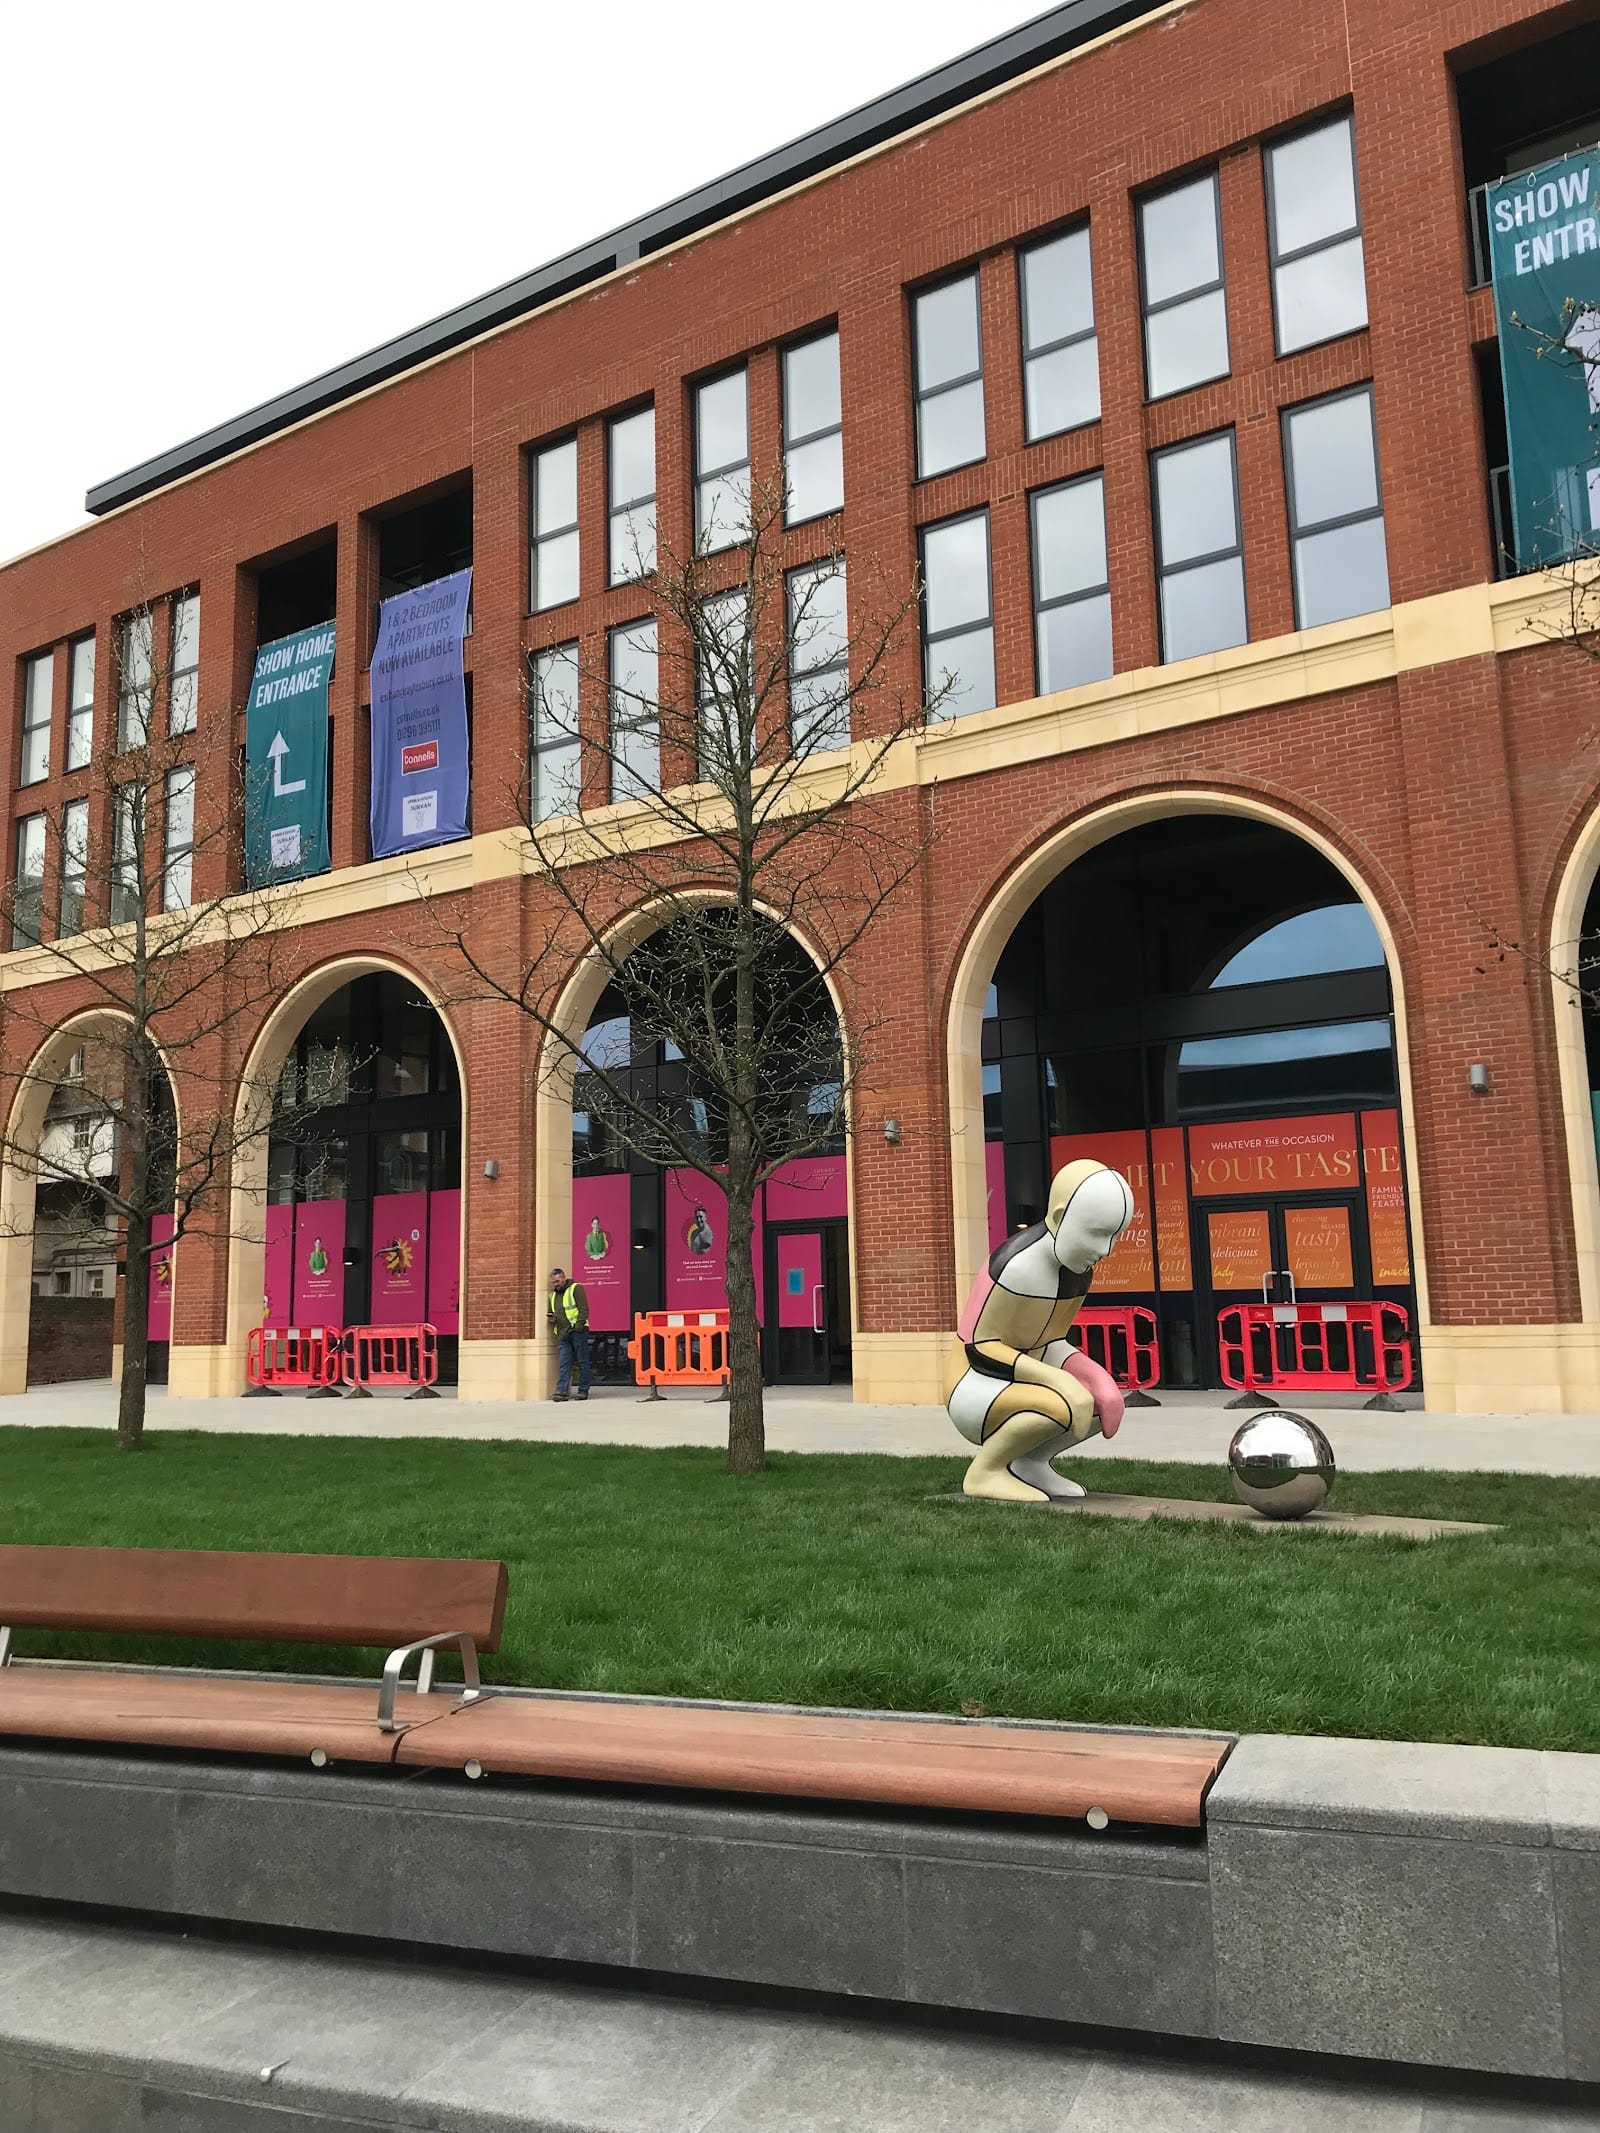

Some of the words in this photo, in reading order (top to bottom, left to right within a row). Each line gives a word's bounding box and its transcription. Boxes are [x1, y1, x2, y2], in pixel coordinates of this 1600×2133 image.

[1495, 167, 1590, 233] SHOW
[1514, 217, 1600, 276] ENTR
[410, 591, 459, 620] BEDROOM
[387, 615, 451, 651] APARTMENTS
[255, 645, 295, 679] SHOW
[295, 631, 336, 665] HOME
[378, 653, 402, 675] NOW
[401, 636, 455, 668] AVAILABLE
[255, 665, 323, 709] ENTRANCE
[404, 751, 435, 765] Connells
[1211, 1139, 1262, 1151] WHATEVER
[1264, 1138, 1280, 1146] THE
[1281, 1134, 1335, 1146] OCCASION
[1190, 1156, 1278, 1185] YOUR
[1287, 1146, 1400, 1179] TASTE
[1371, 1185, 1404, 1195] FAMILY
[1372, 1193, 1405, 1201] FRIENDLY
[1372, 1199, 1405, 1208] FEASTS
[1210, 1223, 1262, 1239] vibrant
[1212, 1246, 1259, 1259] delicious
